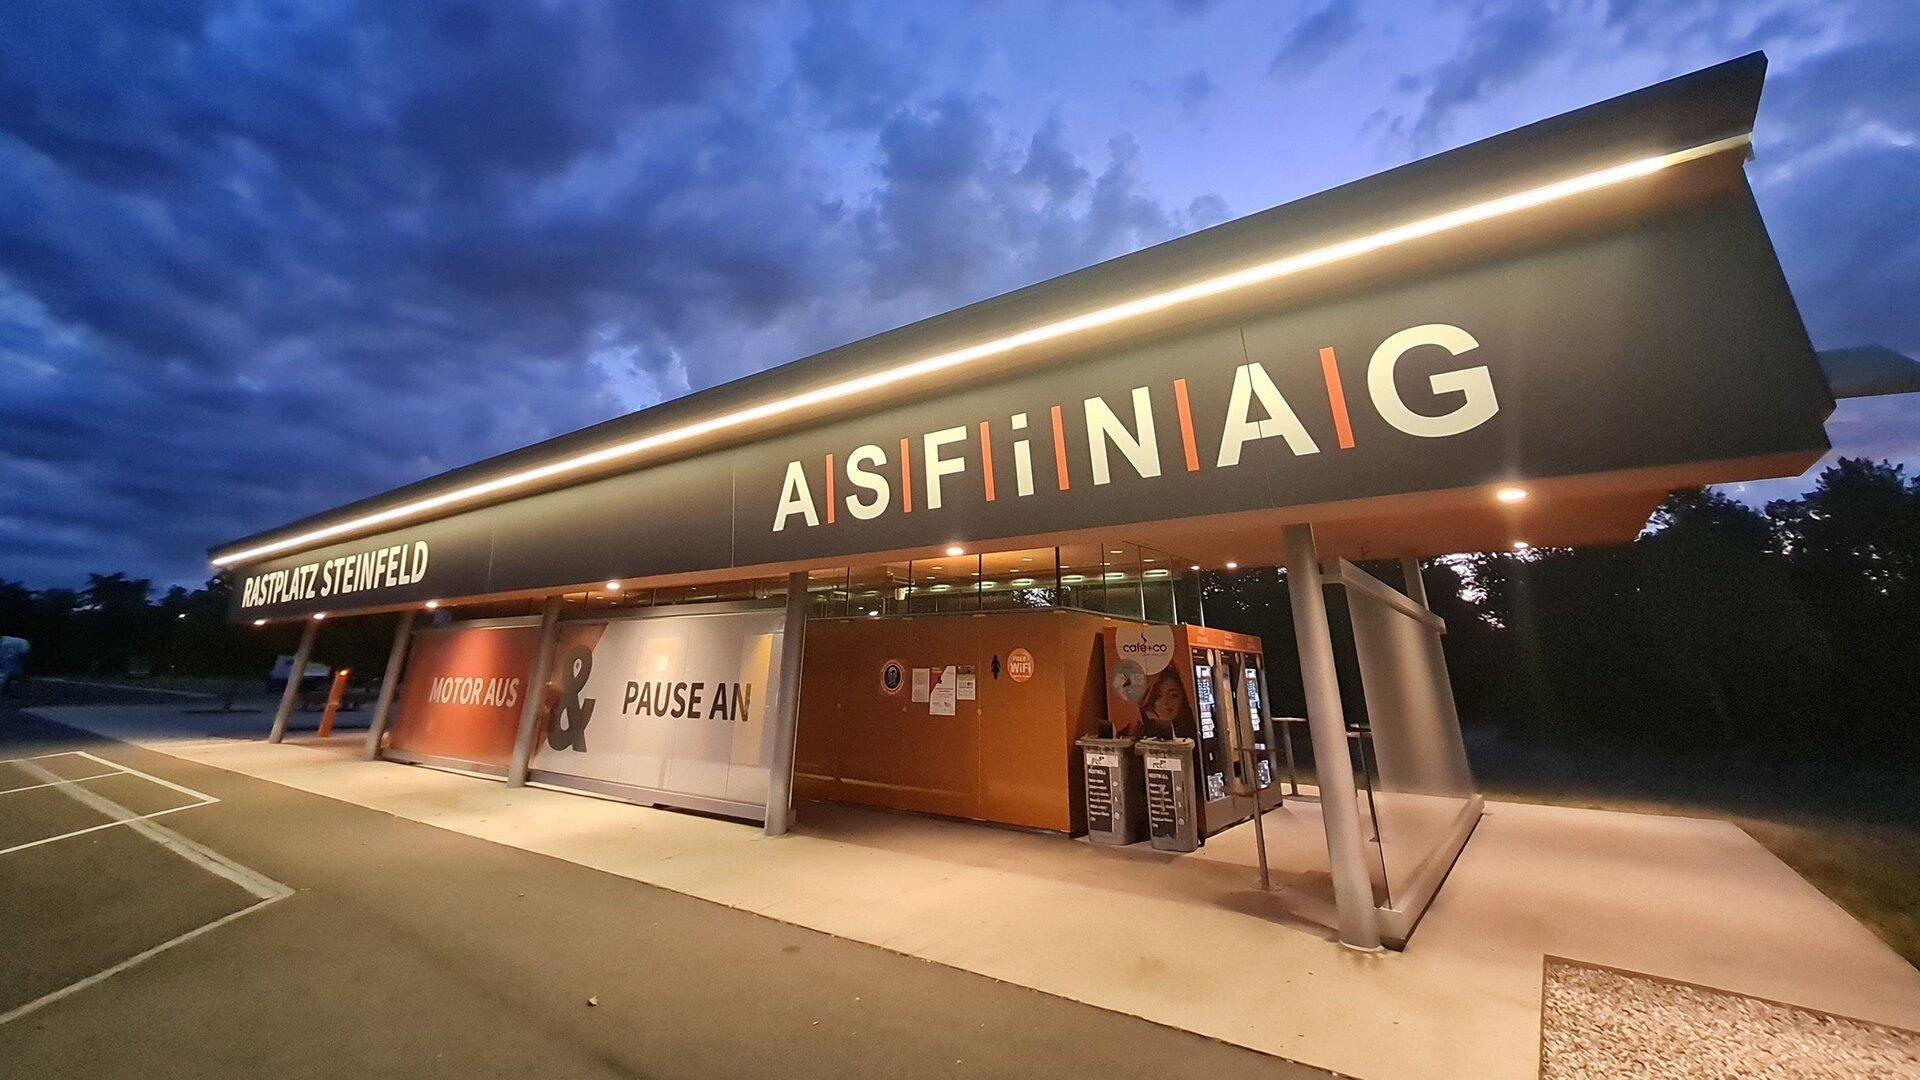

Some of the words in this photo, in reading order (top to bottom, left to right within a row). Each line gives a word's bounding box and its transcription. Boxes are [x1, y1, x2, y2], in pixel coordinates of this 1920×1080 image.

[241, 563, 320, 608] RASTPLATZ
[320, 540, 429, 597] STEINFELD
[429, 676, 484, 705] MOTOR
[482, 677, 519, 707] AUS
[547, 645, 596, 753] &
[622, 681, 704, 719] PAUSE
[708, 682, 752, 721] AN
